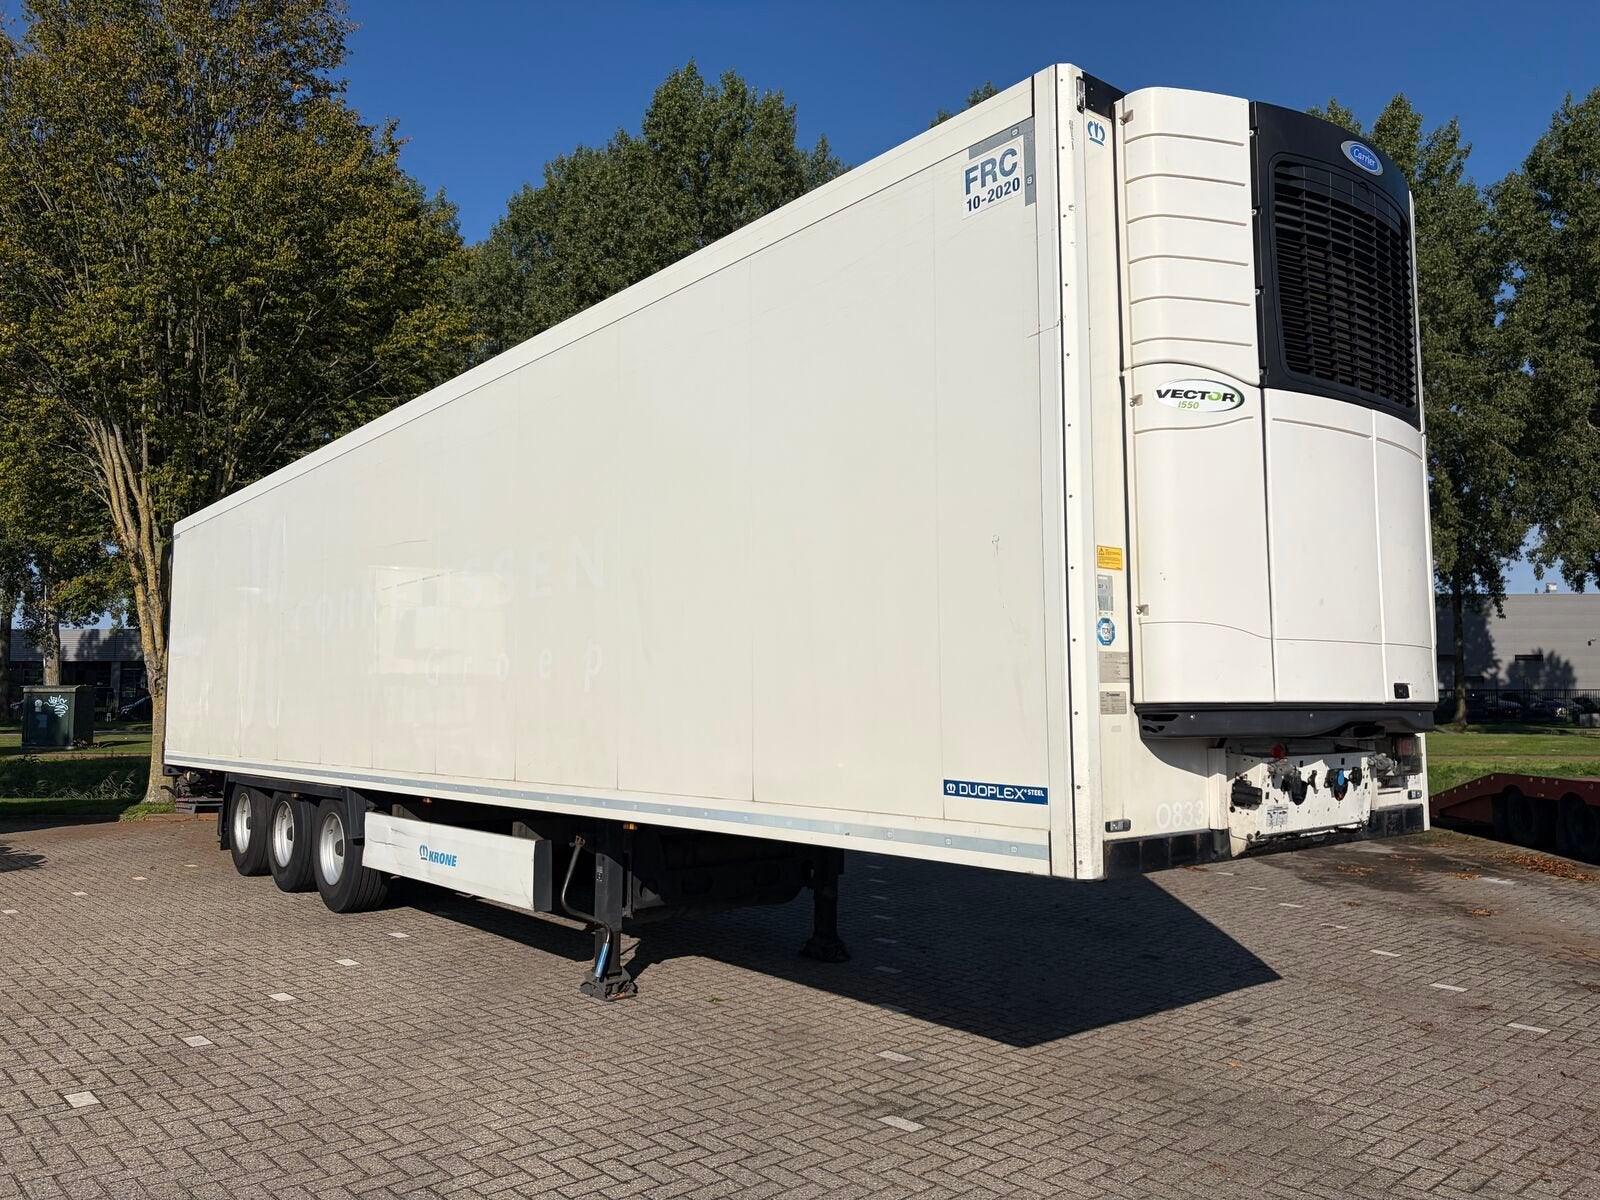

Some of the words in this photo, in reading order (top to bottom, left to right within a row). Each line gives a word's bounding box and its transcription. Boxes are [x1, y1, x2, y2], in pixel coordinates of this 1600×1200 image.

[964, 147, 1018, 195] FRC
[966, 177, 1020, 212] 10-2020
[1156, 389, 1236, 403] VECTOR
[1178, 400, 1199, 409] 1550
[958, 783, 1026, 801] DUOPLEX
[1027, 789, 1045, 797] STEEL
[1156, 799, 1204, 829] 0833
[428, 850, 457, 867] KRONE
